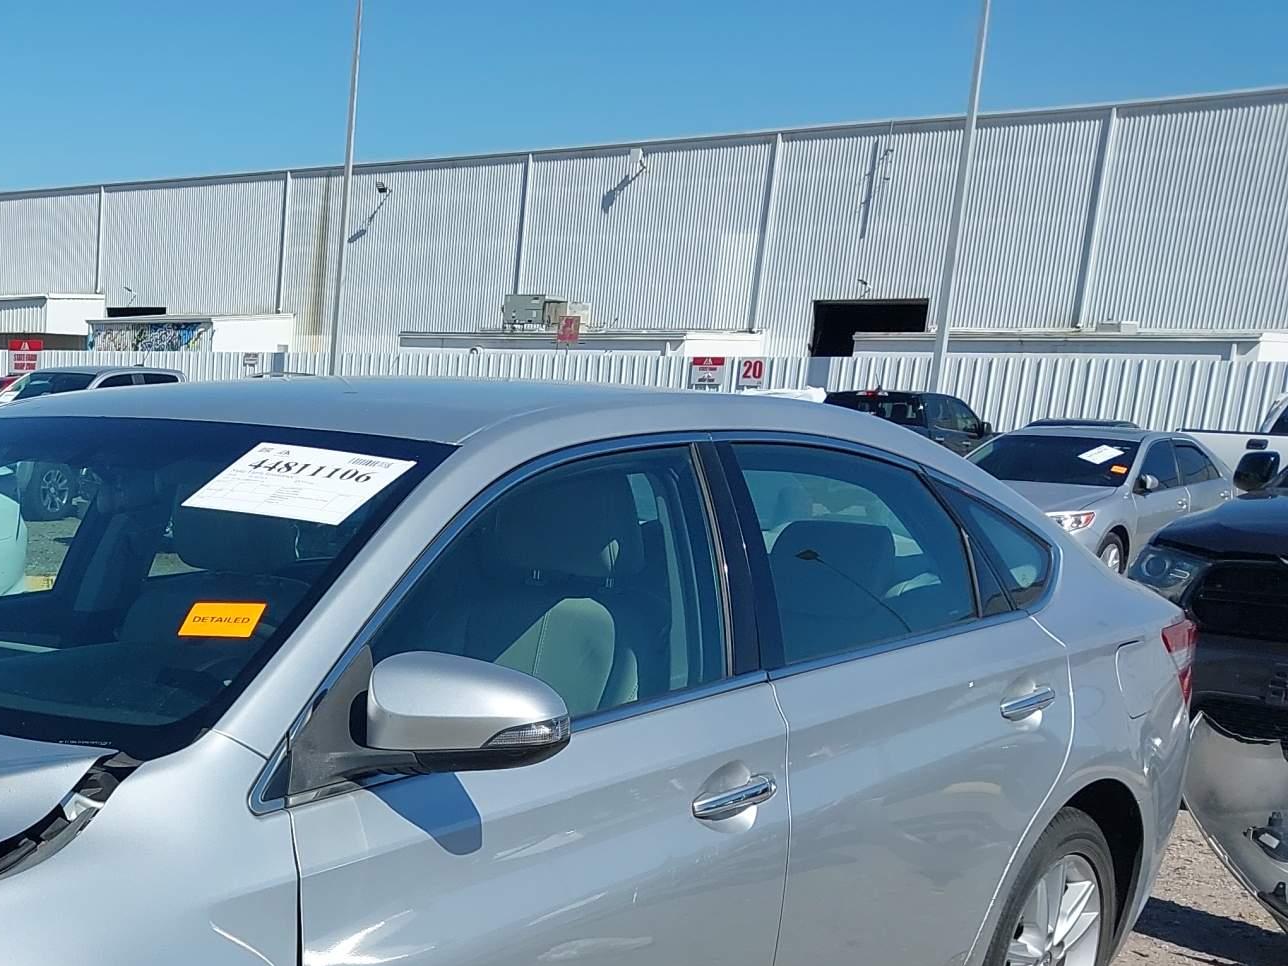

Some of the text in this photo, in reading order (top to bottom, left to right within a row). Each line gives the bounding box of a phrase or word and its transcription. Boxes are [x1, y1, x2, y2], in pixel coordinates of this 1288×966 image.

[742, 360, 763, 379] 20
[248, 459, 377, 484] 44811106
[192, 615, 251, 624] DETAILED
